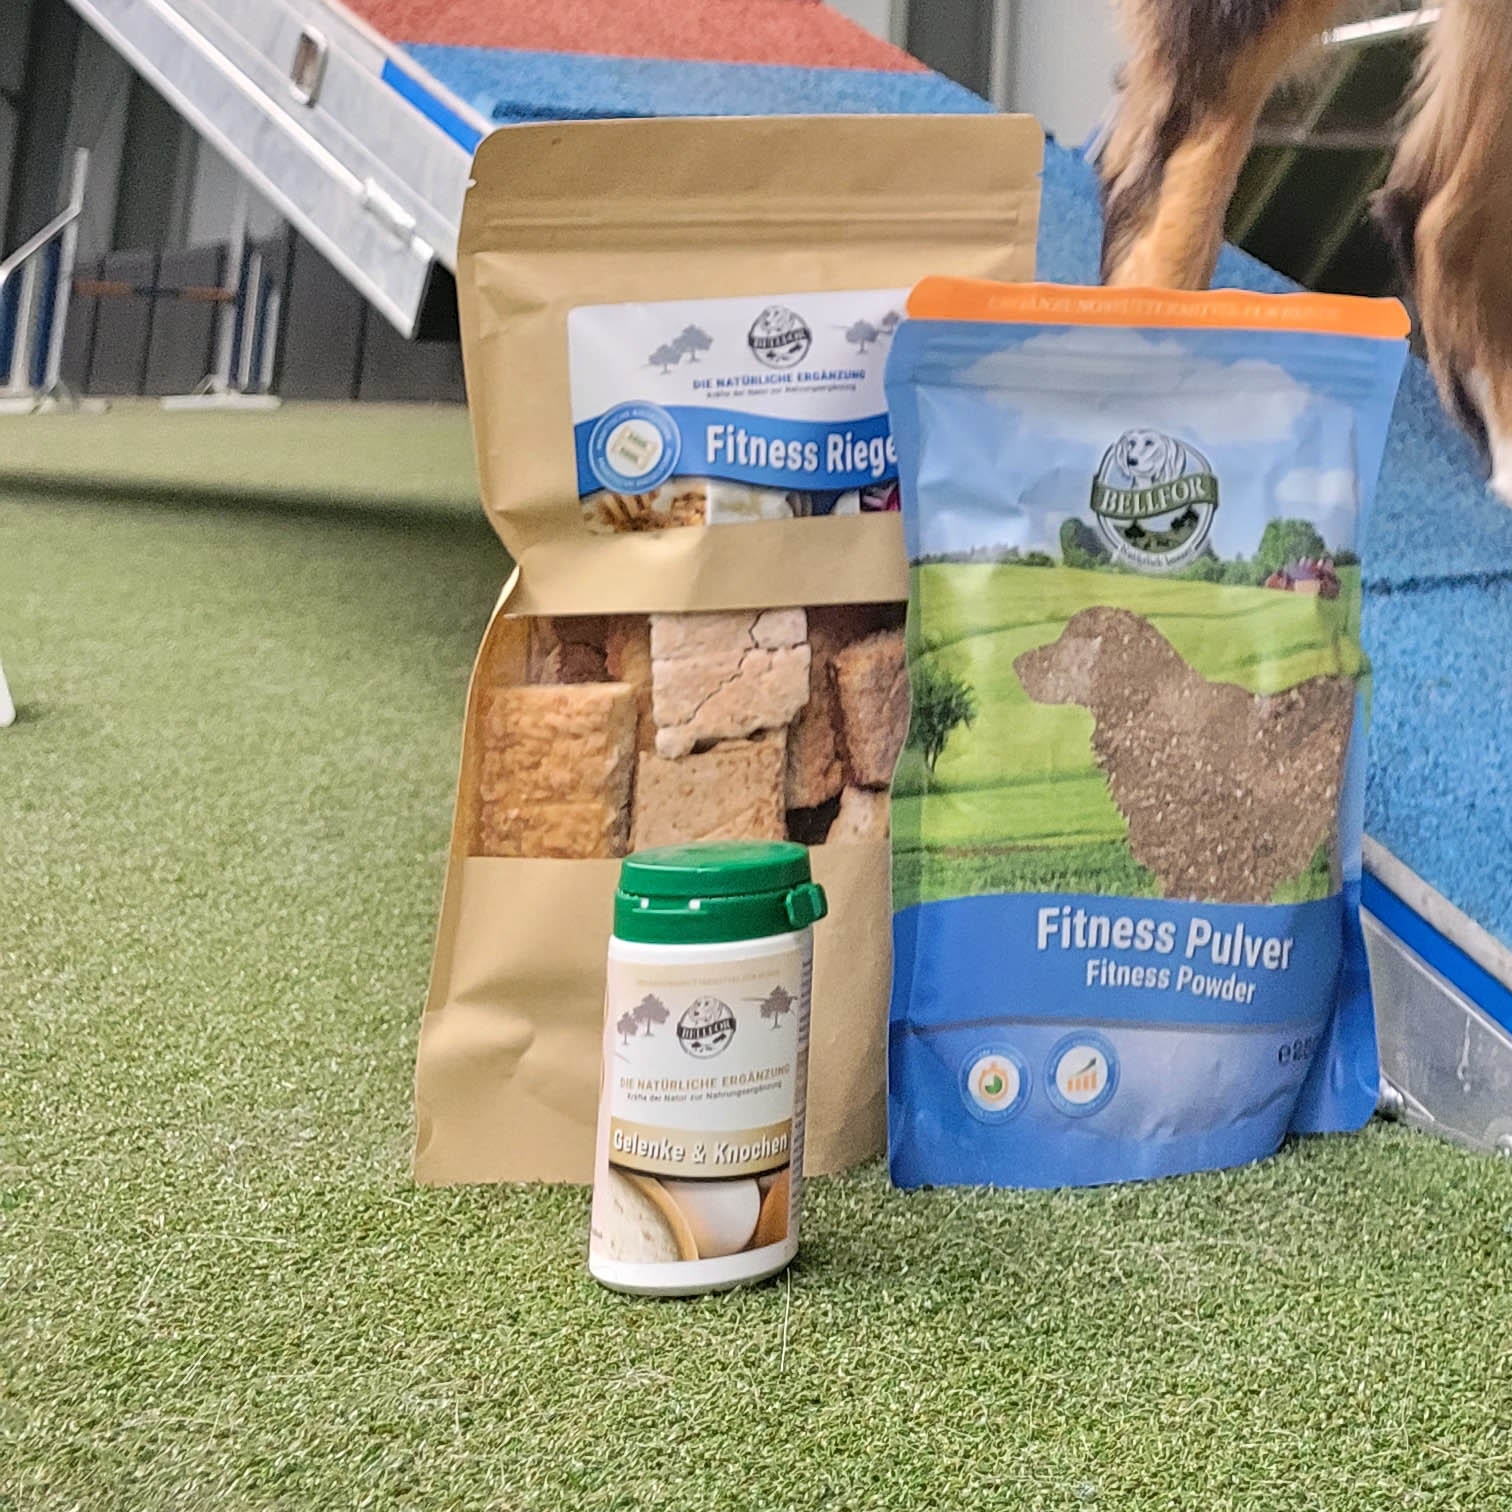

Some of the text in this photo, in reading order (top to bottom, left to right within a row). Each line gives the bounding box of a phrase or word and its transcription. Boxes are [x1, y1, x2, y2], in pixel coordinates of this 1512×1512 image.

[692, 369, 866, 390] DIE NATÜRLICHE ERGÄNZUNG
[706, 424, 818, 472] Fitness
[827, 430, 897, 478] Riege
[1100, 476, 1206, 516] BELLFOR
[1036, 906, 1294, 972] Fitness Pulver
[1086, 958, 1257, 1004] Fitness Powder
[620, 1063, 791, 1092] DIE NATÜRLICHE ERGÄNZUNG
[613, 1128, 789, 1165] Gelenke & Knochen
